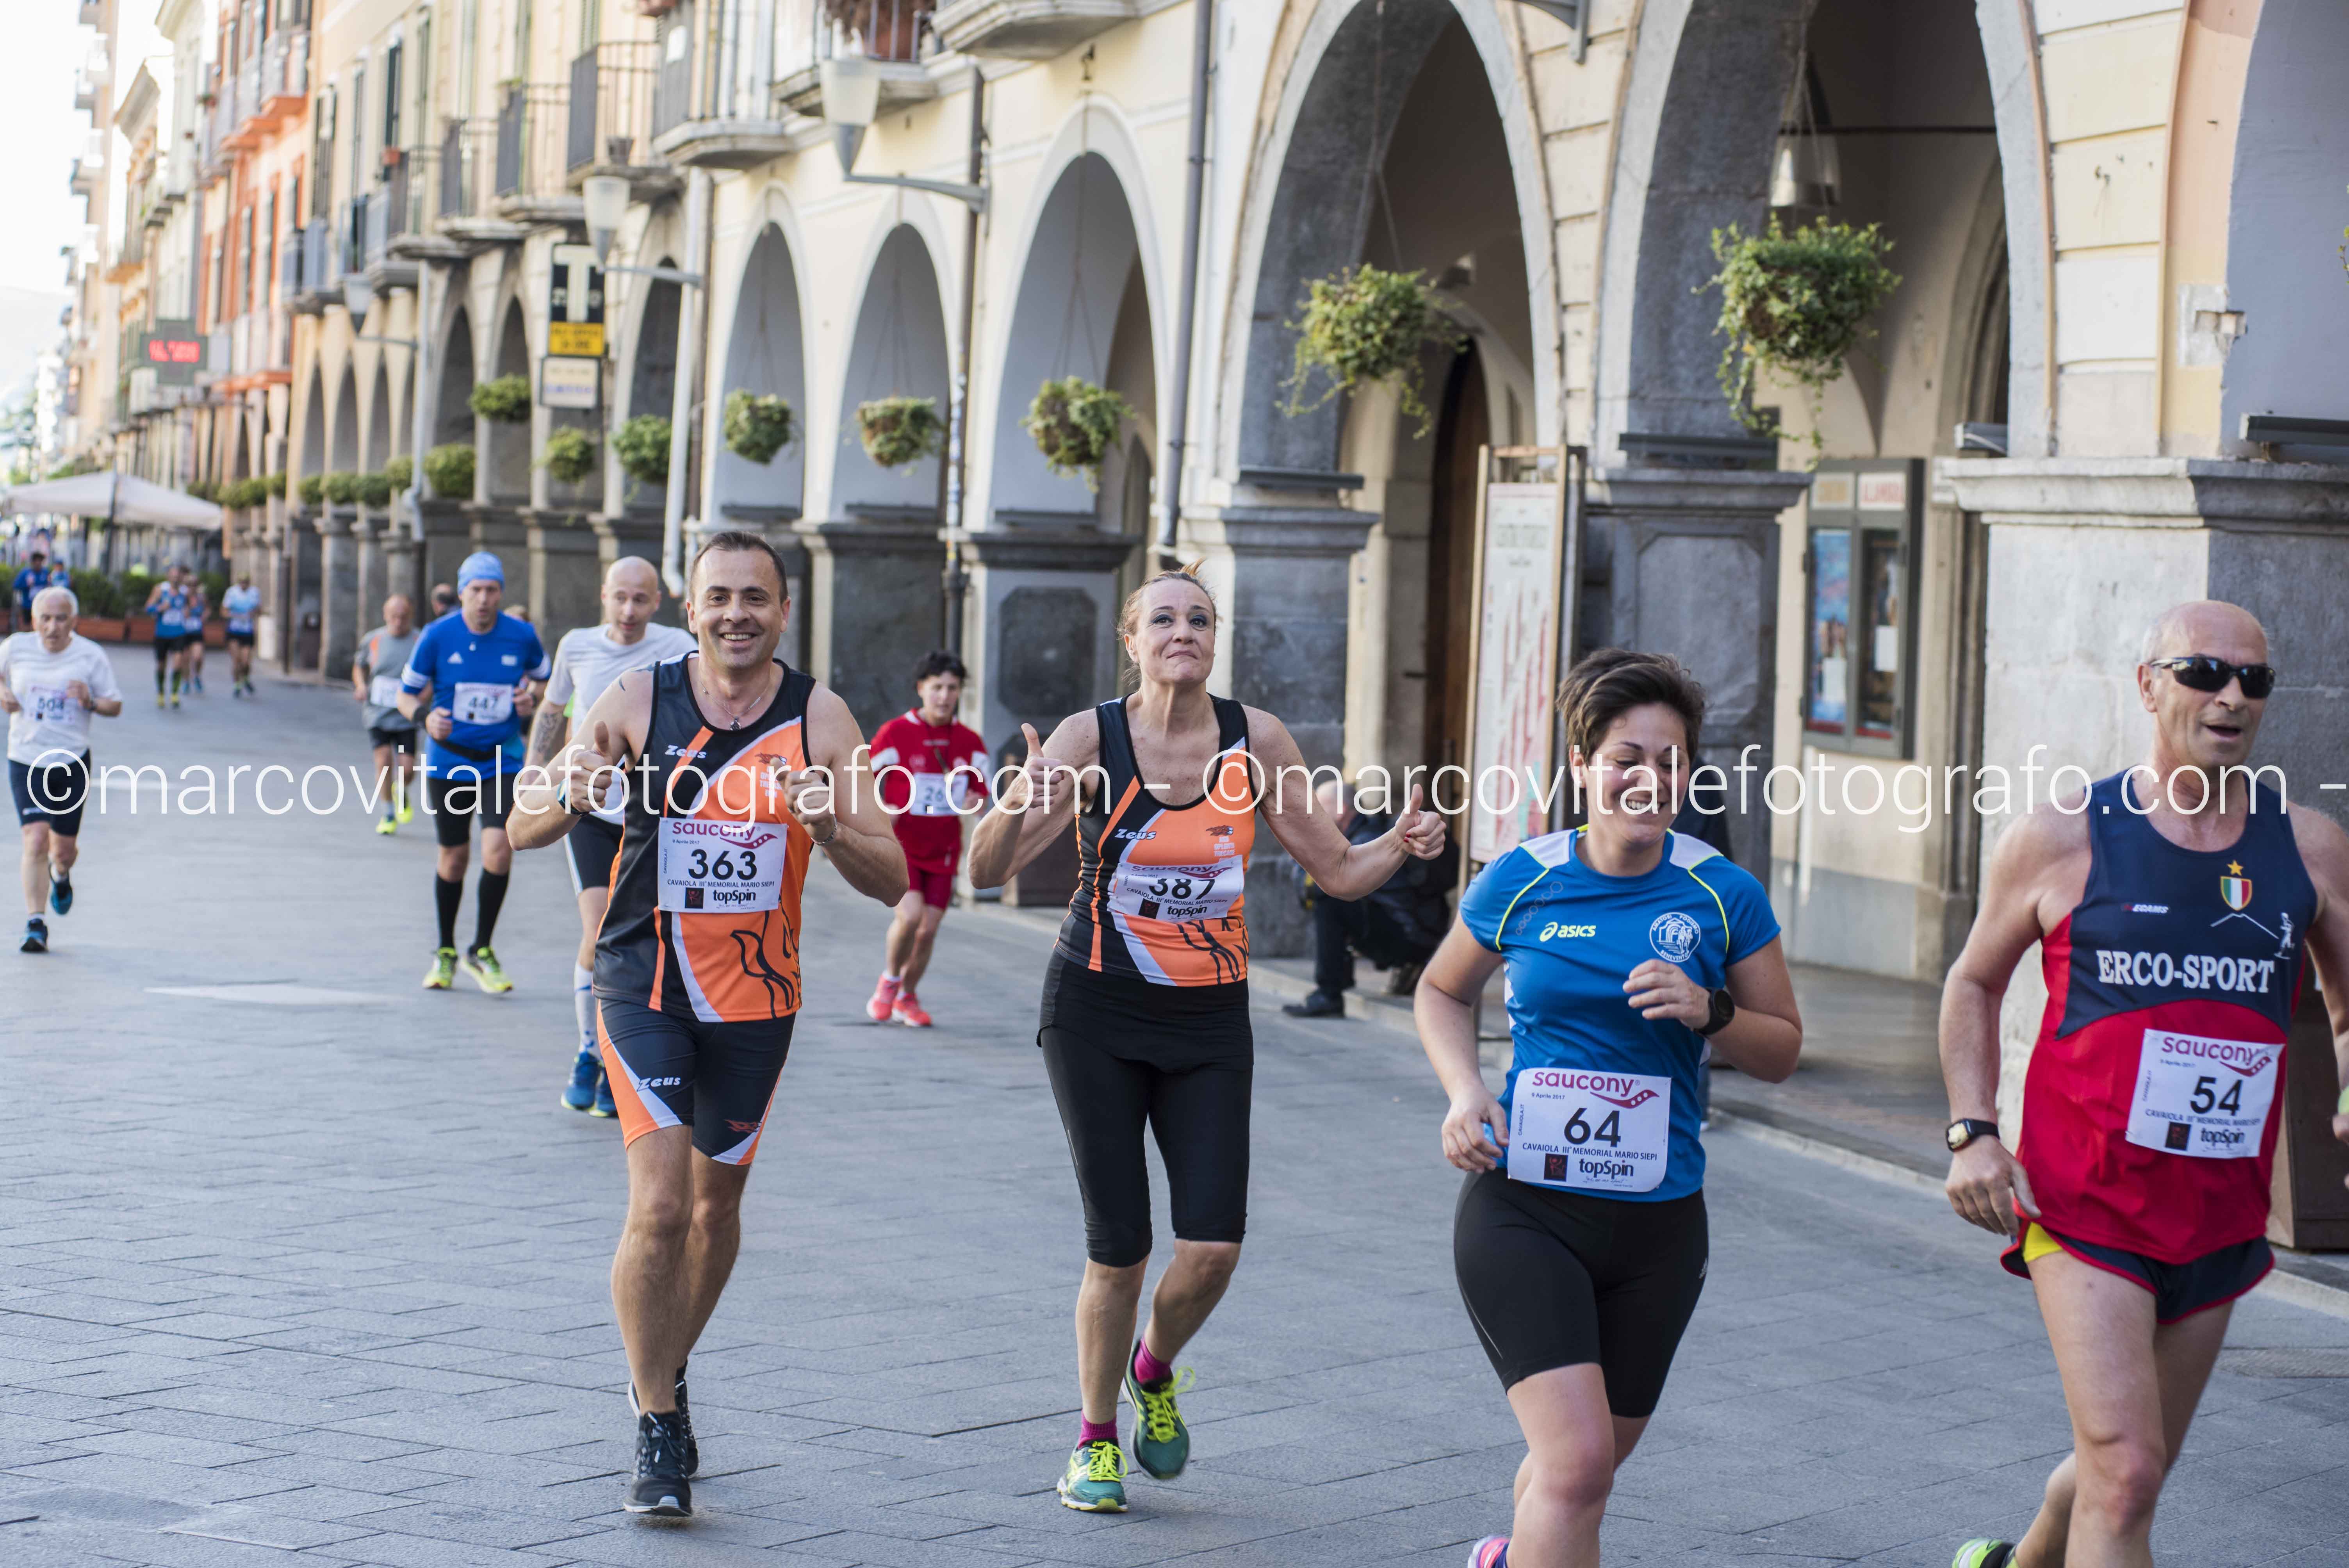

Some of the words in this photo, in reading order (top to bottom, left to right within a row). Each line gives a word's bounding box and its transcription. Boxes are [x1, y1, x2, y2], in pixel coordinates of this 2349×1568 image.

[469, 696, 499, 709] 447
[665, 745, 706, 759] Zeus
[672, 822, 756, 841] saucony
[1114, 828, 1157, 840] Zeus
[688, 849, 757, 880] 363
[713, 889, 756, 904] topSpin
[1126, 888, 1154, 901] CAVAIOLA
[1149, 878, 1215, 900] 387
[1167, 905, 1207, 917] topSpin
[1557, 925, 1597, 938] asics
[2096, 950, 2274, 993] ERCO-SPORT
[2162, 1037, 2256, 1066] saucony
[637, 1077, 681, 1092] Zeus
[1533, 1072, 1634, 1097] saucony
[2190, 1076, 2243, 1116] 54
[1564, 1107, 1621, 1148] 64
[2201, 1128, 2245, 1147] topSpin
[1522, 1142, 1559, 1153] CAVAIOLA
[1572, 1148, 1613, 1158] MEMORIAL
[1615, 1151, 1639, 1159] MARIO
[1640, 1152, 1657, 1161] SIEPI
[1579, 1158, 1634, 1179] topSpin
